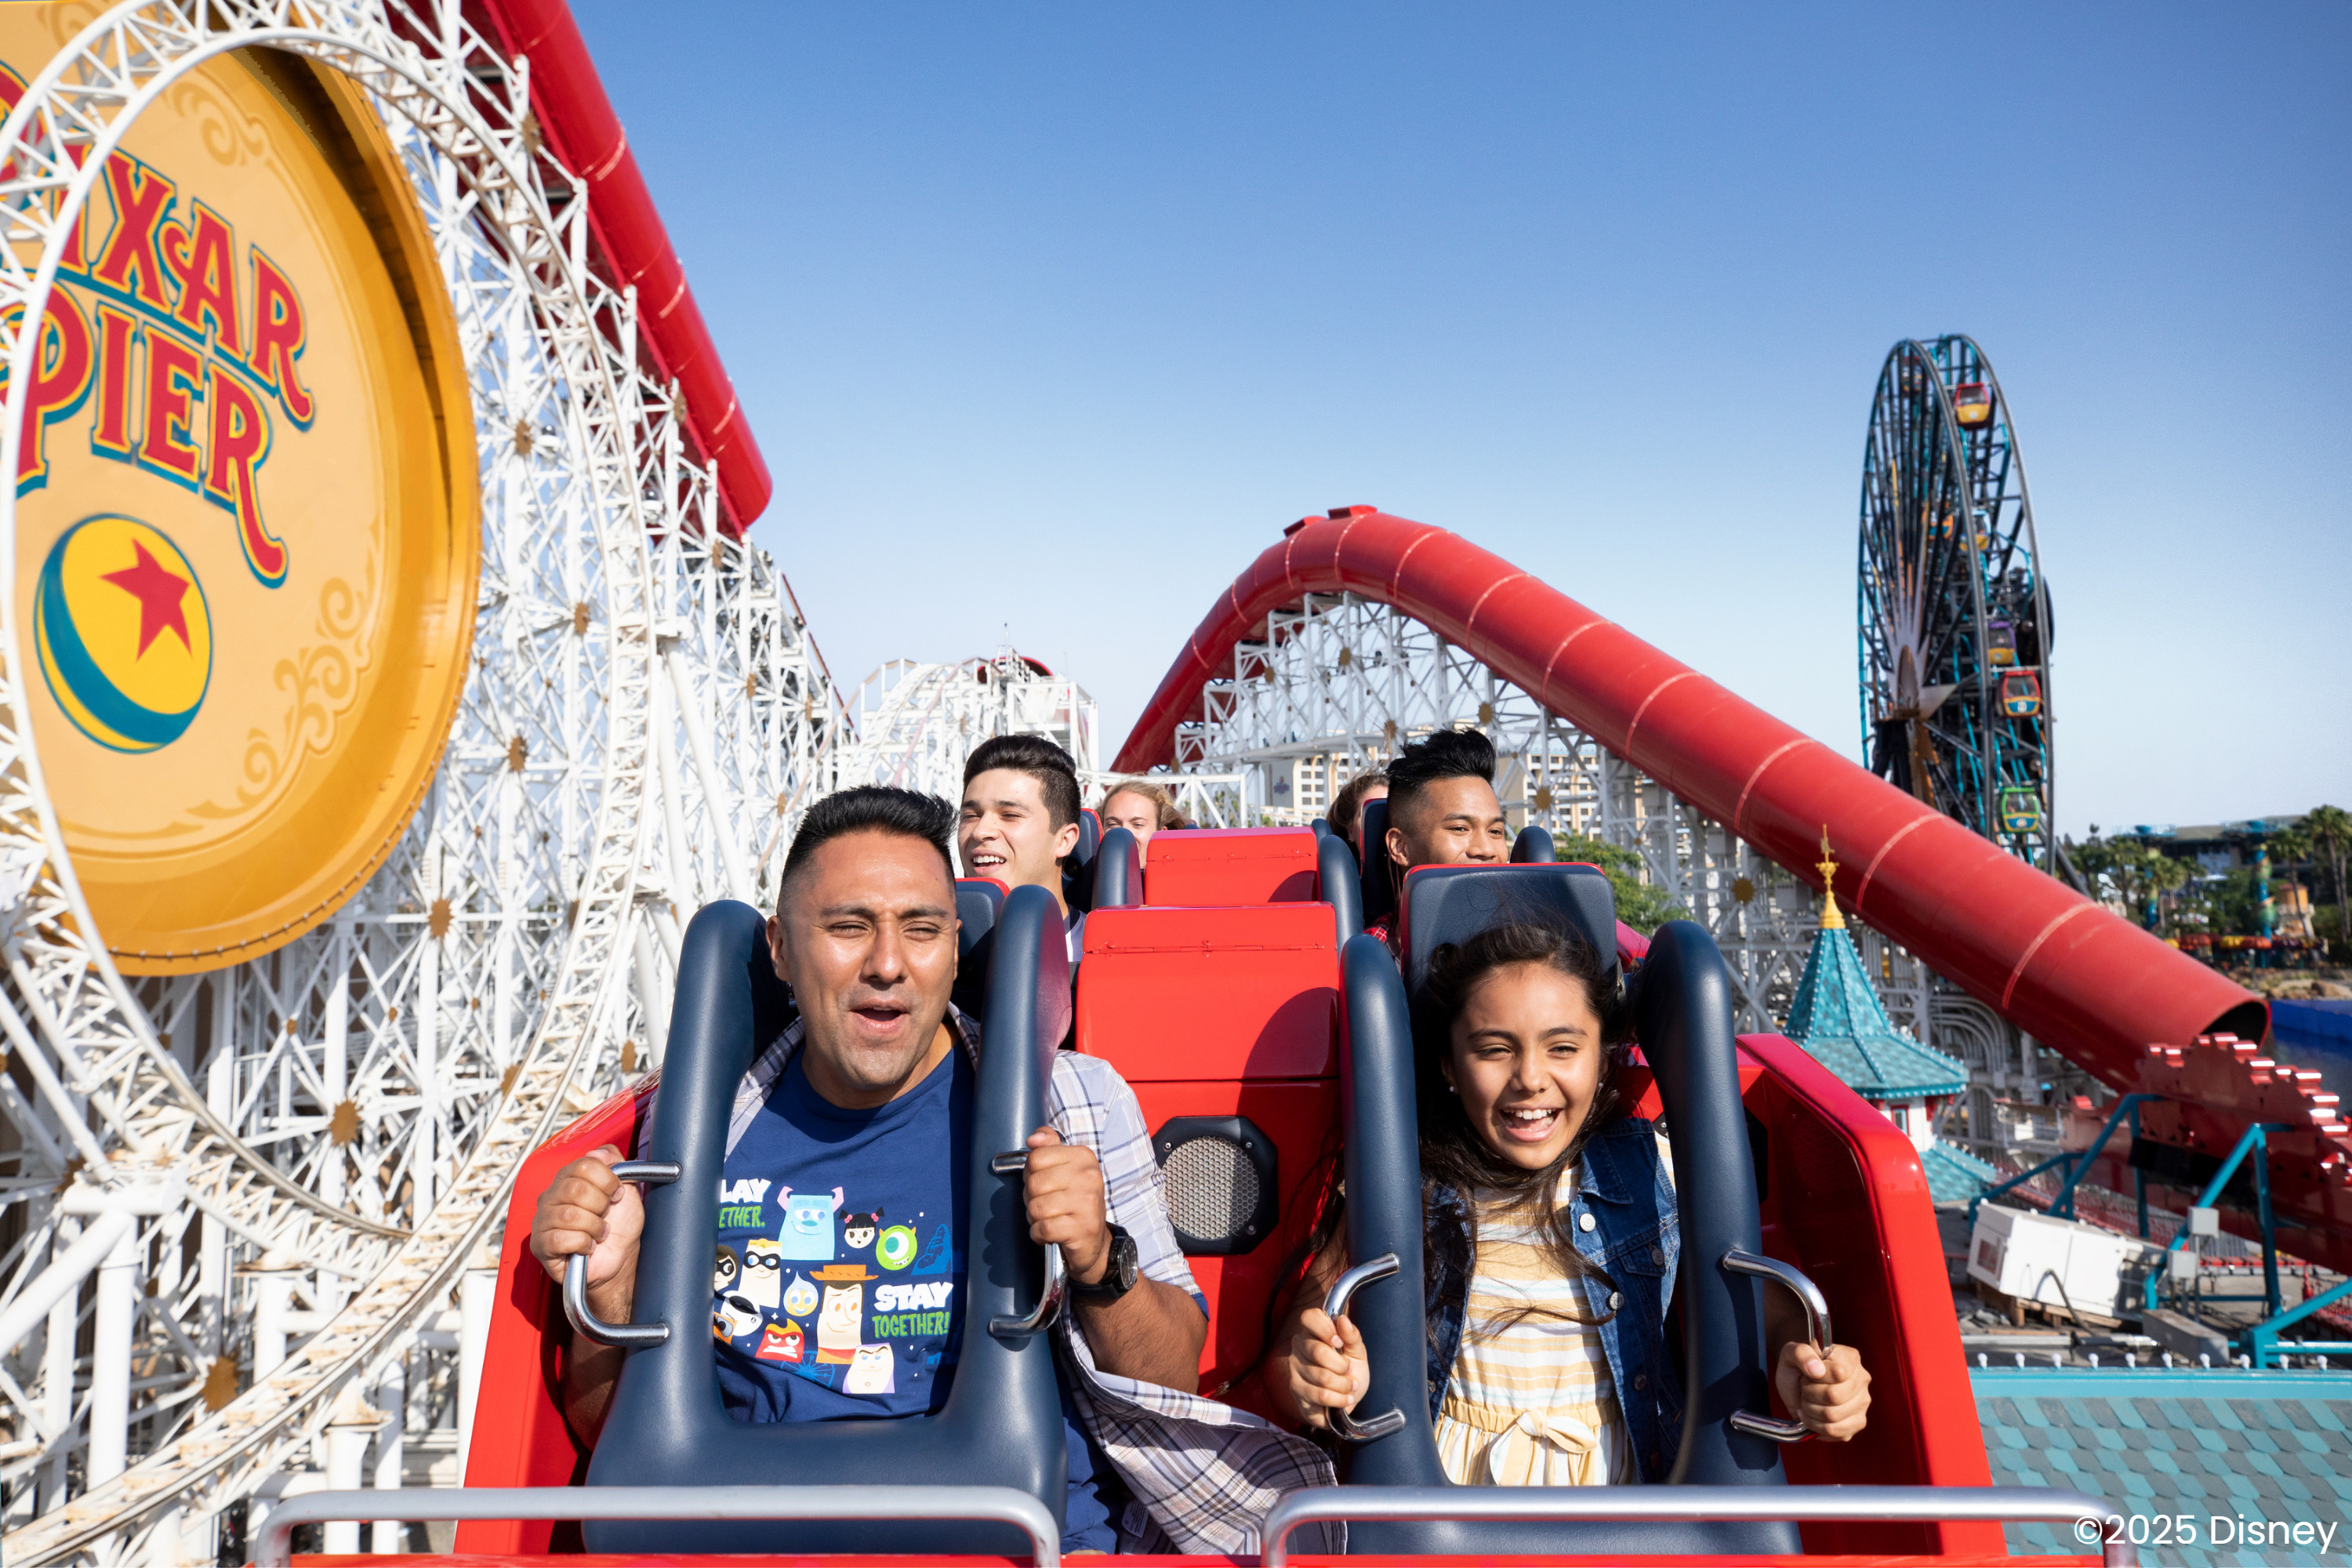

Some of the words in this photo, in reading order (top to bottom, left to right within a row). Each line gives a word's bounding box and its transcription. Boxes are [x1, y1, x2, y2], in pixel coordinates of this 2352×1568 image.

[0, 270, 288, 589] PIER
[720, 1178, 772, 1205] LAY
[718, 1205, 766, 1229] ETHER.
[873, 1281, 954, 1312] STAY
[872, 1311, 951, 1338] TOGETHER!
